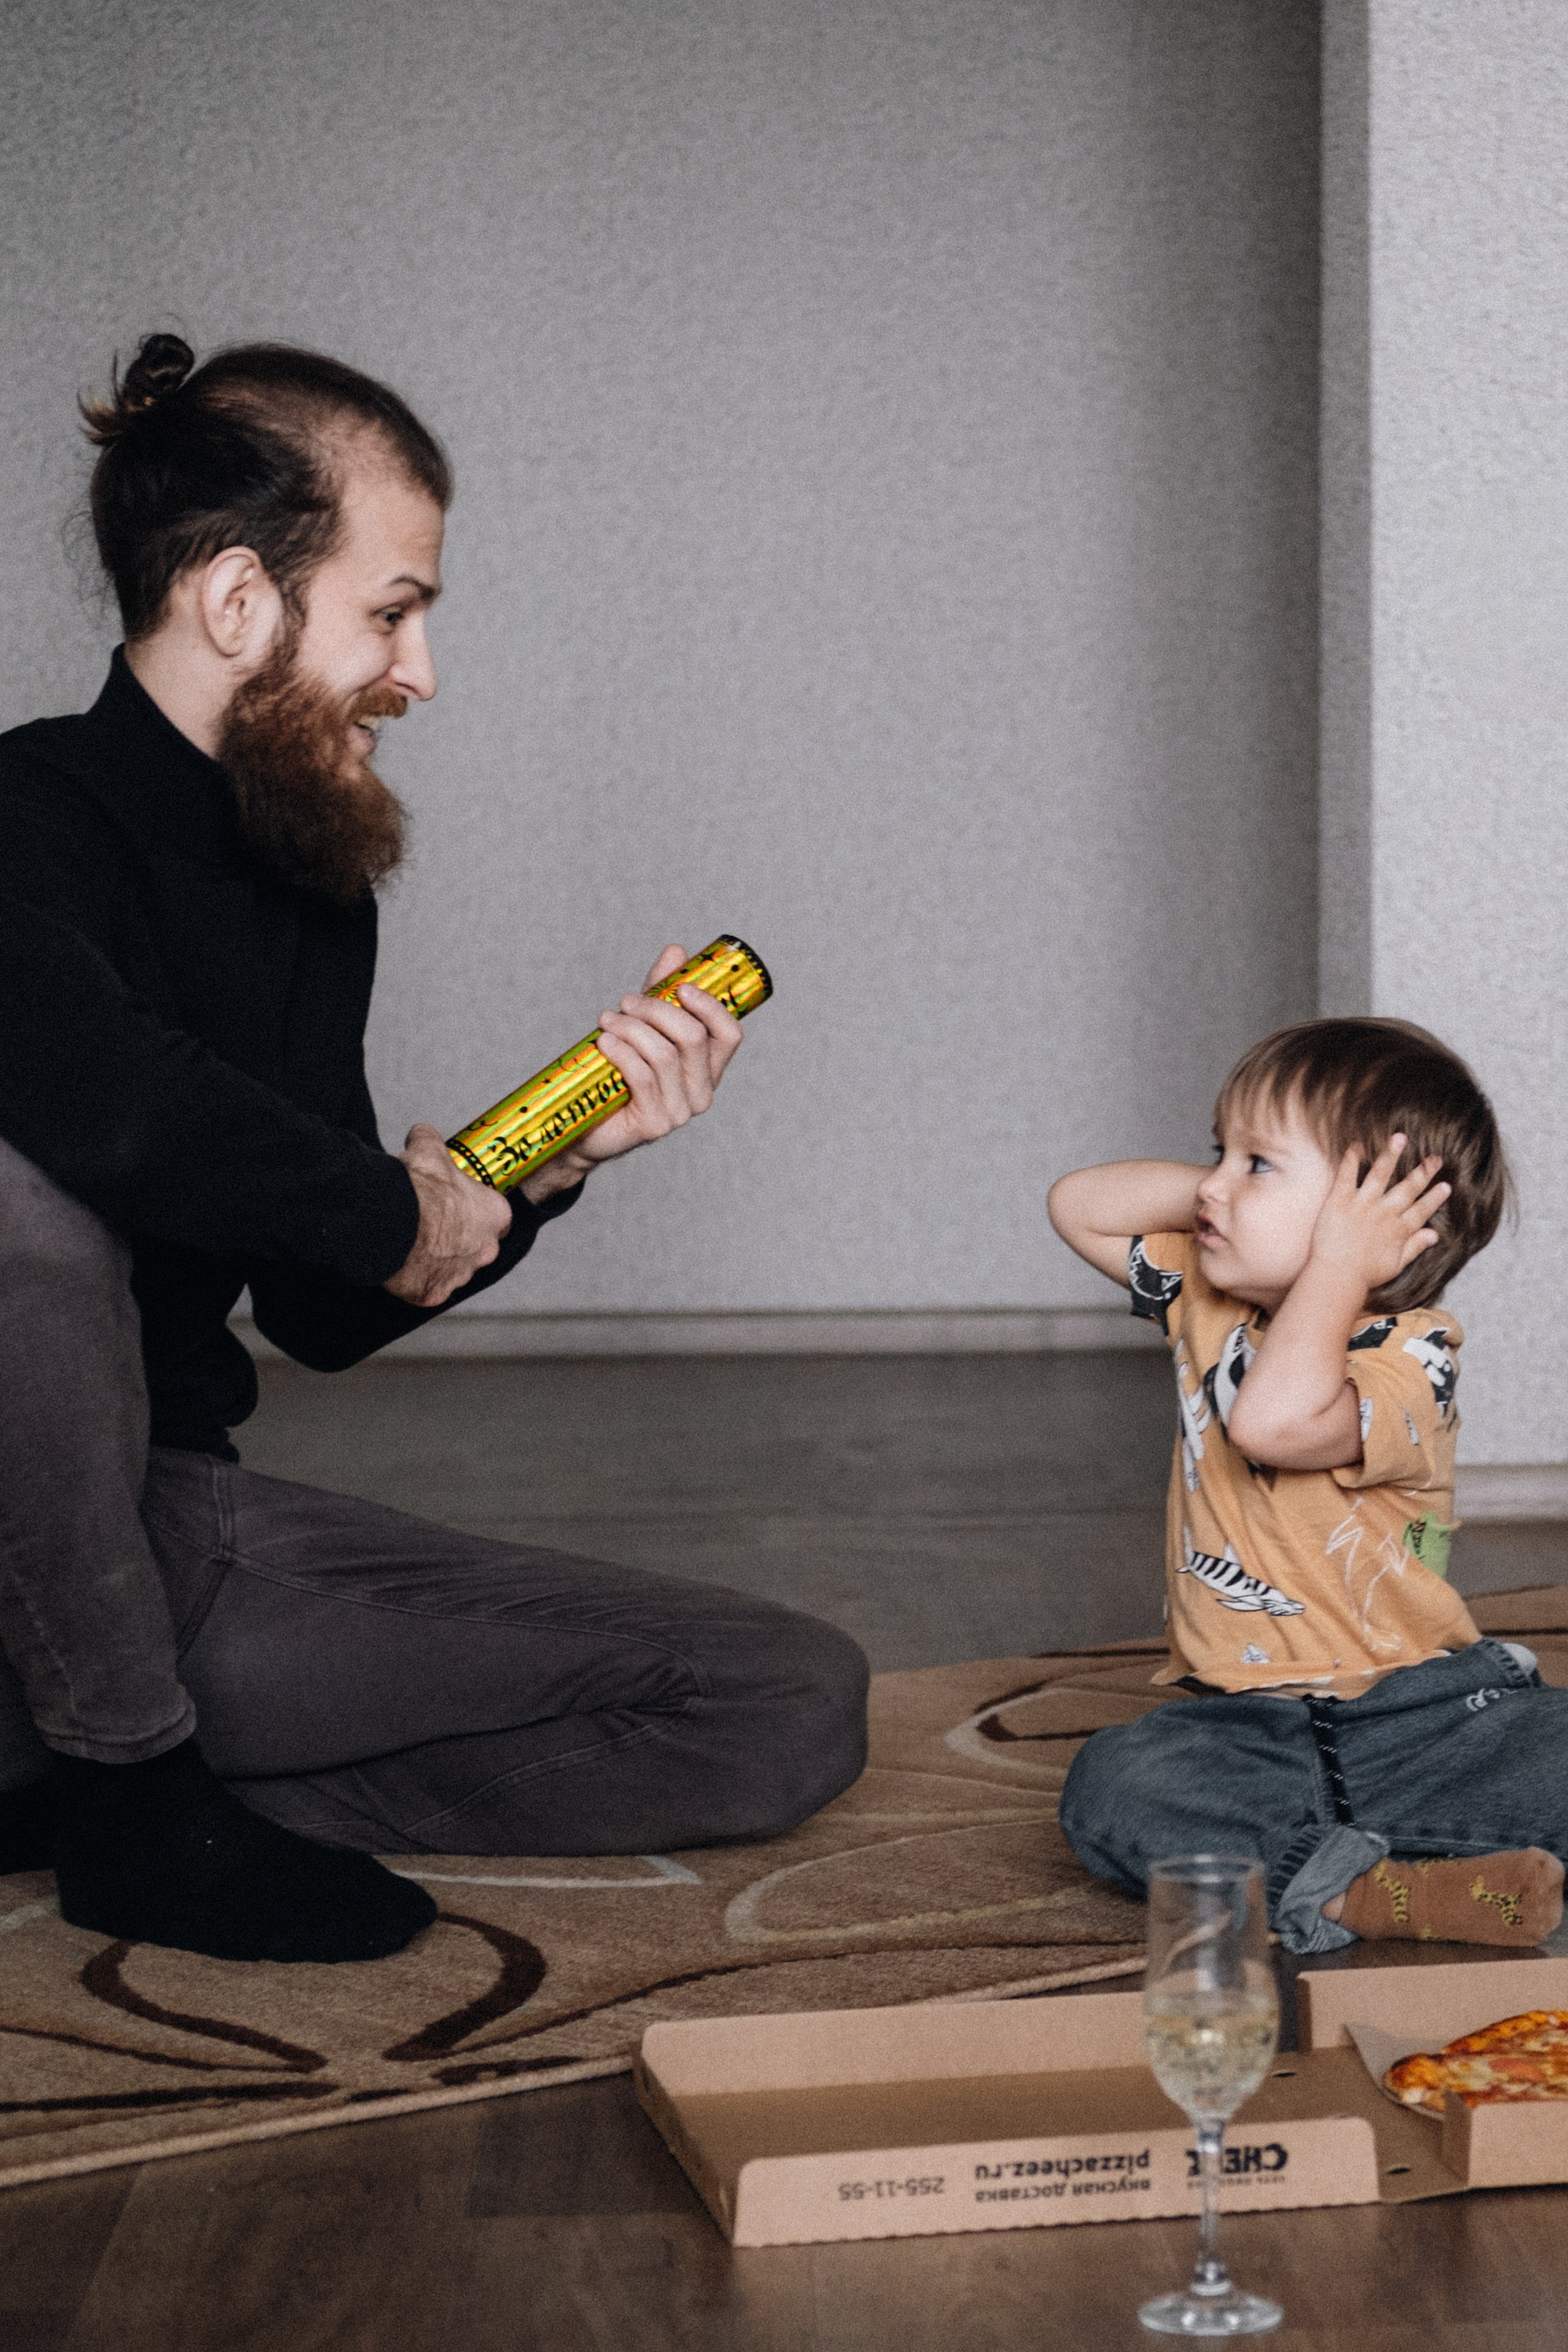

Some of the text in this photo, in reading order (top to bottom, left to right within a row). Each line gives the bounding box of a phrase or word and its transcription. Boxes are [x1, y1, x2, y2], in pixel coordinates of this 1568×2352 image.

[975, 2149, 1150, 2179] pizzacheez.ru
[838, 2176, 945, 2201] 255-11-55
[975, 2178, 1151, 2203] вкусная доставка
